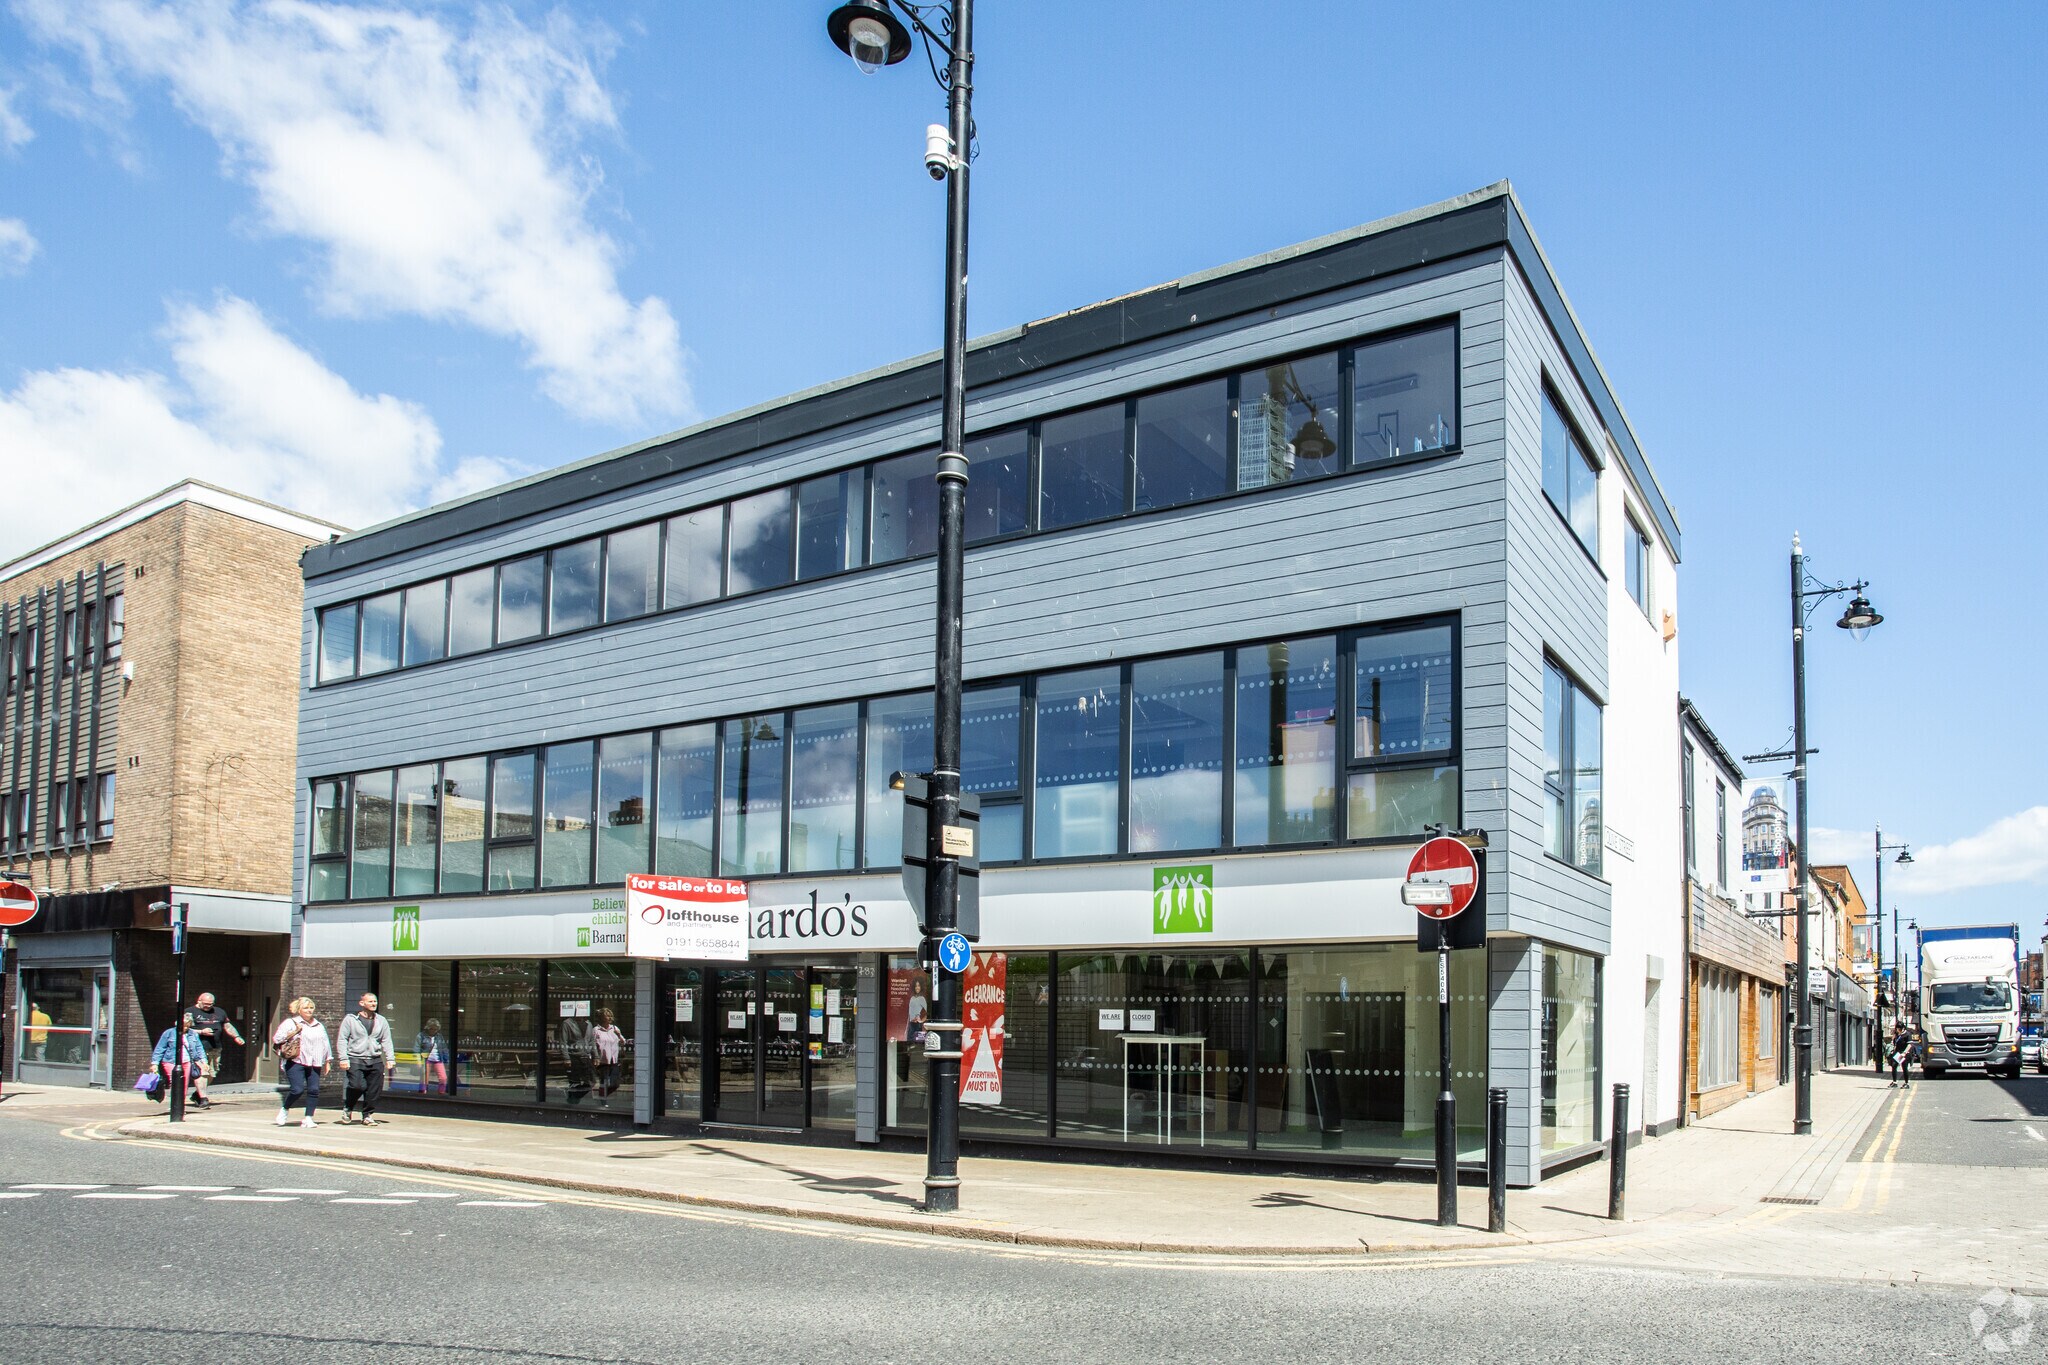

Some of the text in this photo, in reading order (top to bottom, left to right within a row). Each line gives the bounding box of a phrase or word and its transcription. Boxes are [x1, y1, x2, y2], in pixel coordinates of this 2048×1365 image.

[1774, 812, 1783, 856] Shopping
[1619, 838, 1632, 856] STREET
[632, 876, 656, 889] for
[658, 880, 692, 892] sale
[706, 882, 722, 893] to
[726, 883, 746, 895] let
[592, 898, 626, 910] Believ
[667, 909, 739, 923] lofthouse
[666, 937, 740, 948] 0191 5658844
[965, 984, 1005, 1003] CLEARANCE
[970, 1071, 997, 1079] EVERYTHING
[966, 1081, 999, 1092] MUST GO
